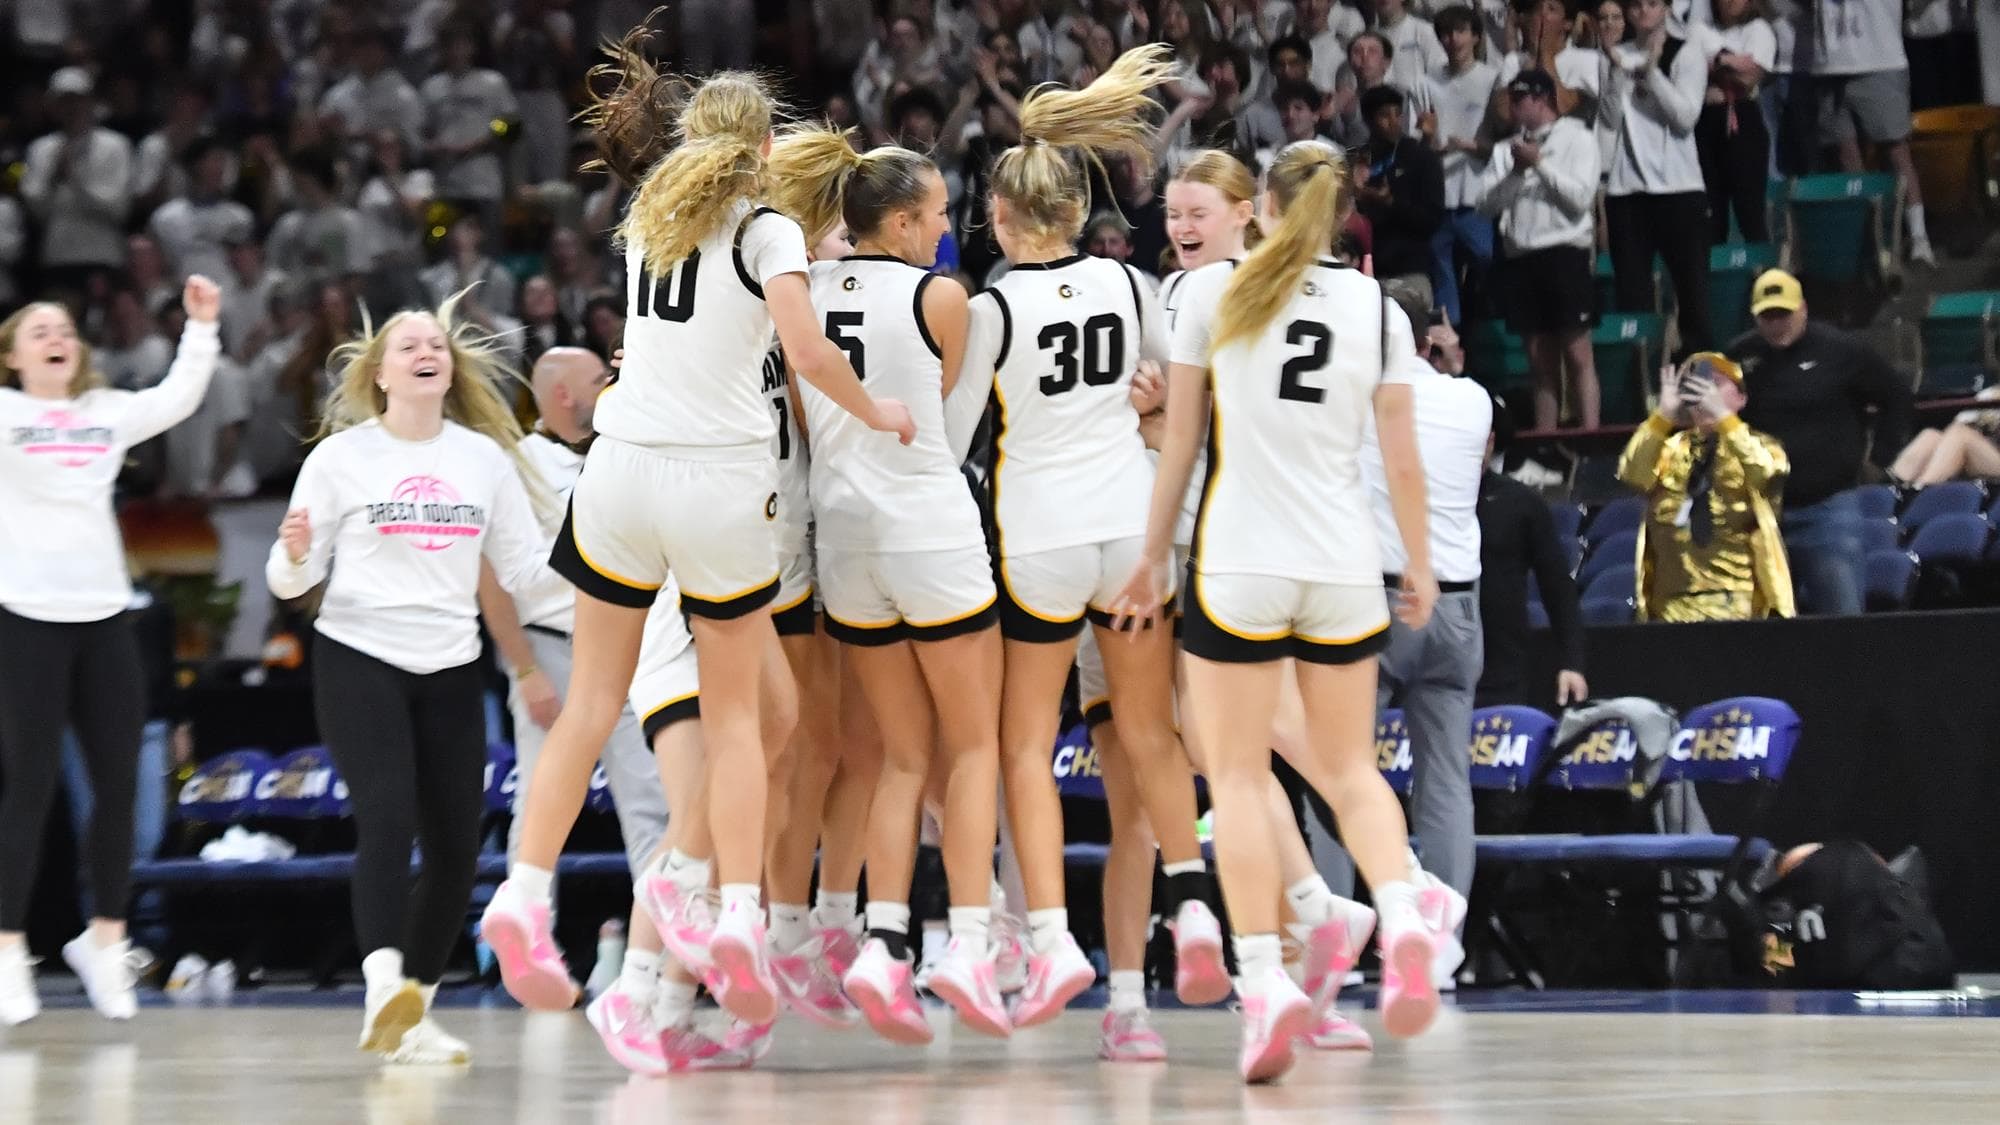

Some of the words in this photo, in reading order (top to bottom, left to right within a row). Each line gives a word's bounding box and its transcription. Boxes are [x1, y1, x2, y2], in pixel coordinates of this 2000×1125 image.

[637, 245, 702, 324] 10
[825, 311, 865, 381] 5
[1038, 313, 1125, 396] 30
[1279, 319, 1335, 405] 2
[1669, 726, 1771, 762] CHSAA
